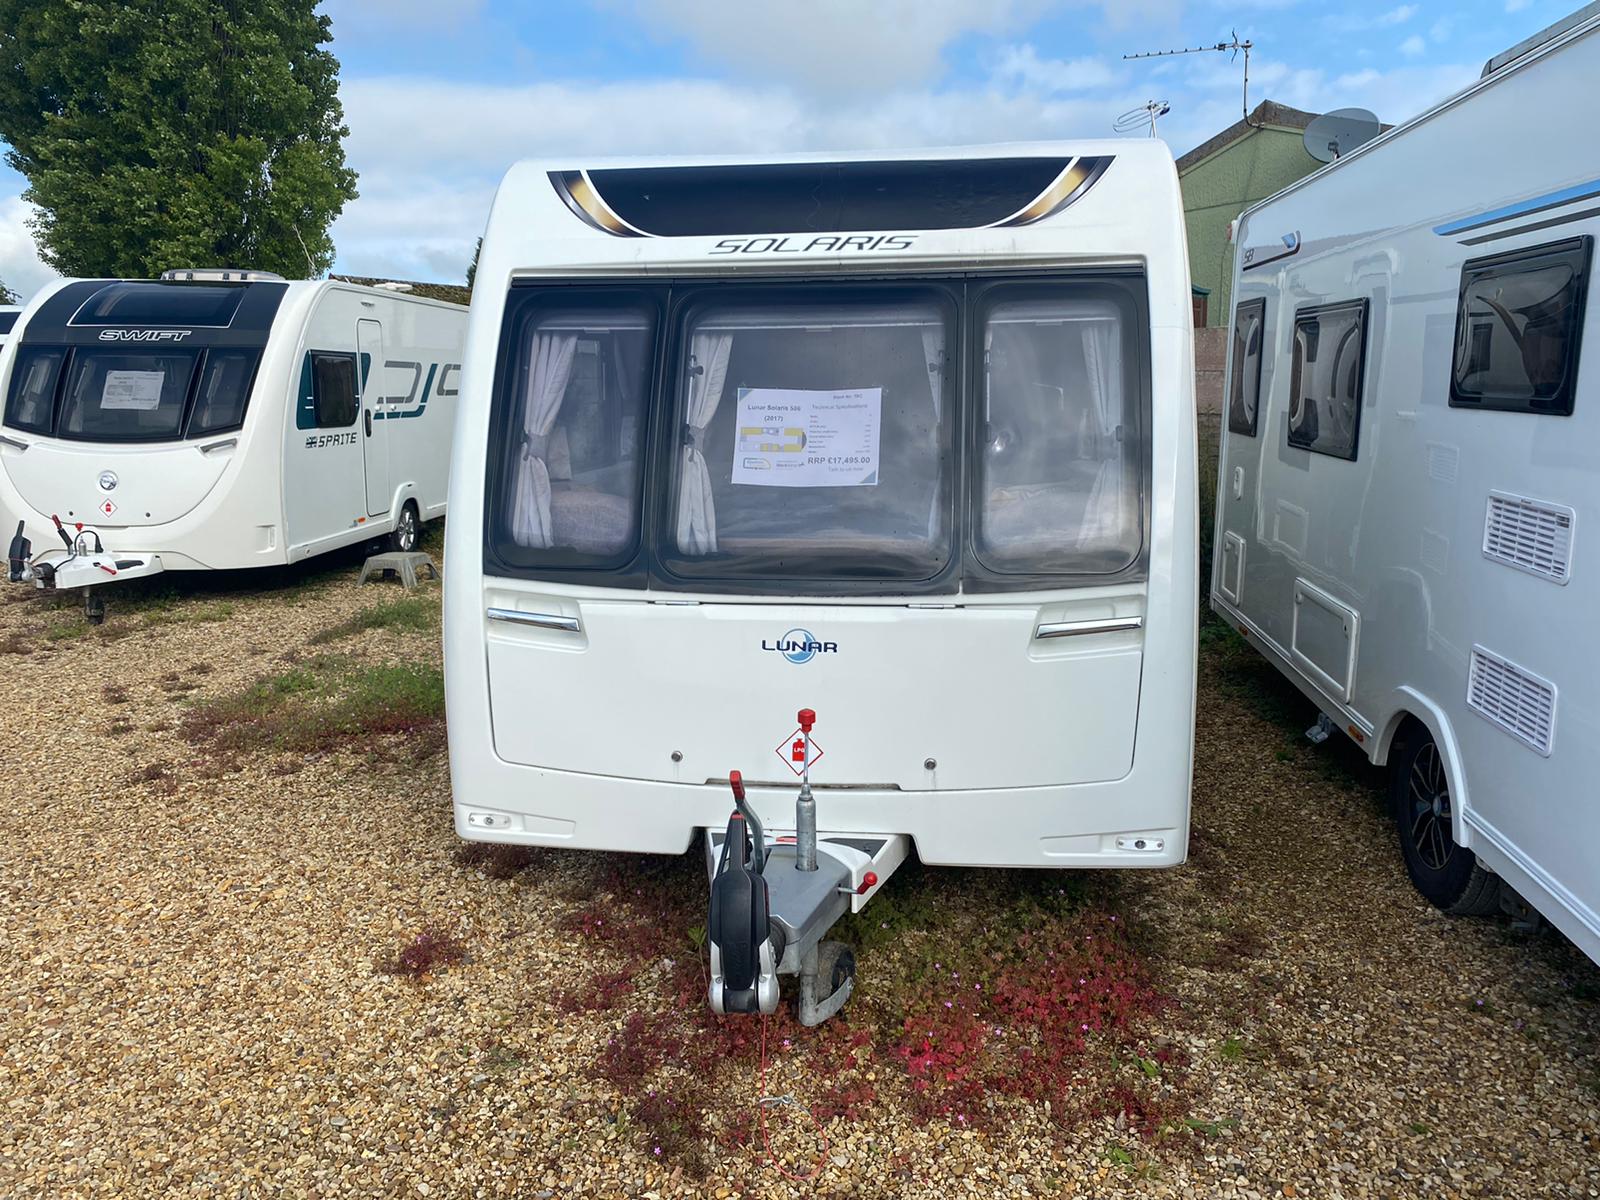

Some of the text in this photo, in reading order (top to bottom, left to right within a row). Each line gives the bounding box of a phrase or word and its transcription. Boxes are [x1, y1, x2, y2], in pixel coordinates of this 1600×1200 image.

[708, 235, 919, 255] SOLARIS
[98, 329, 192, 341] SWIFT
[318, 432, 357, 447] SPRITE
[807, 456, 826, 465] RRP
[828, 456, 871, 465] £17,495.00
[761, 639, 838, 653] LUNAR
